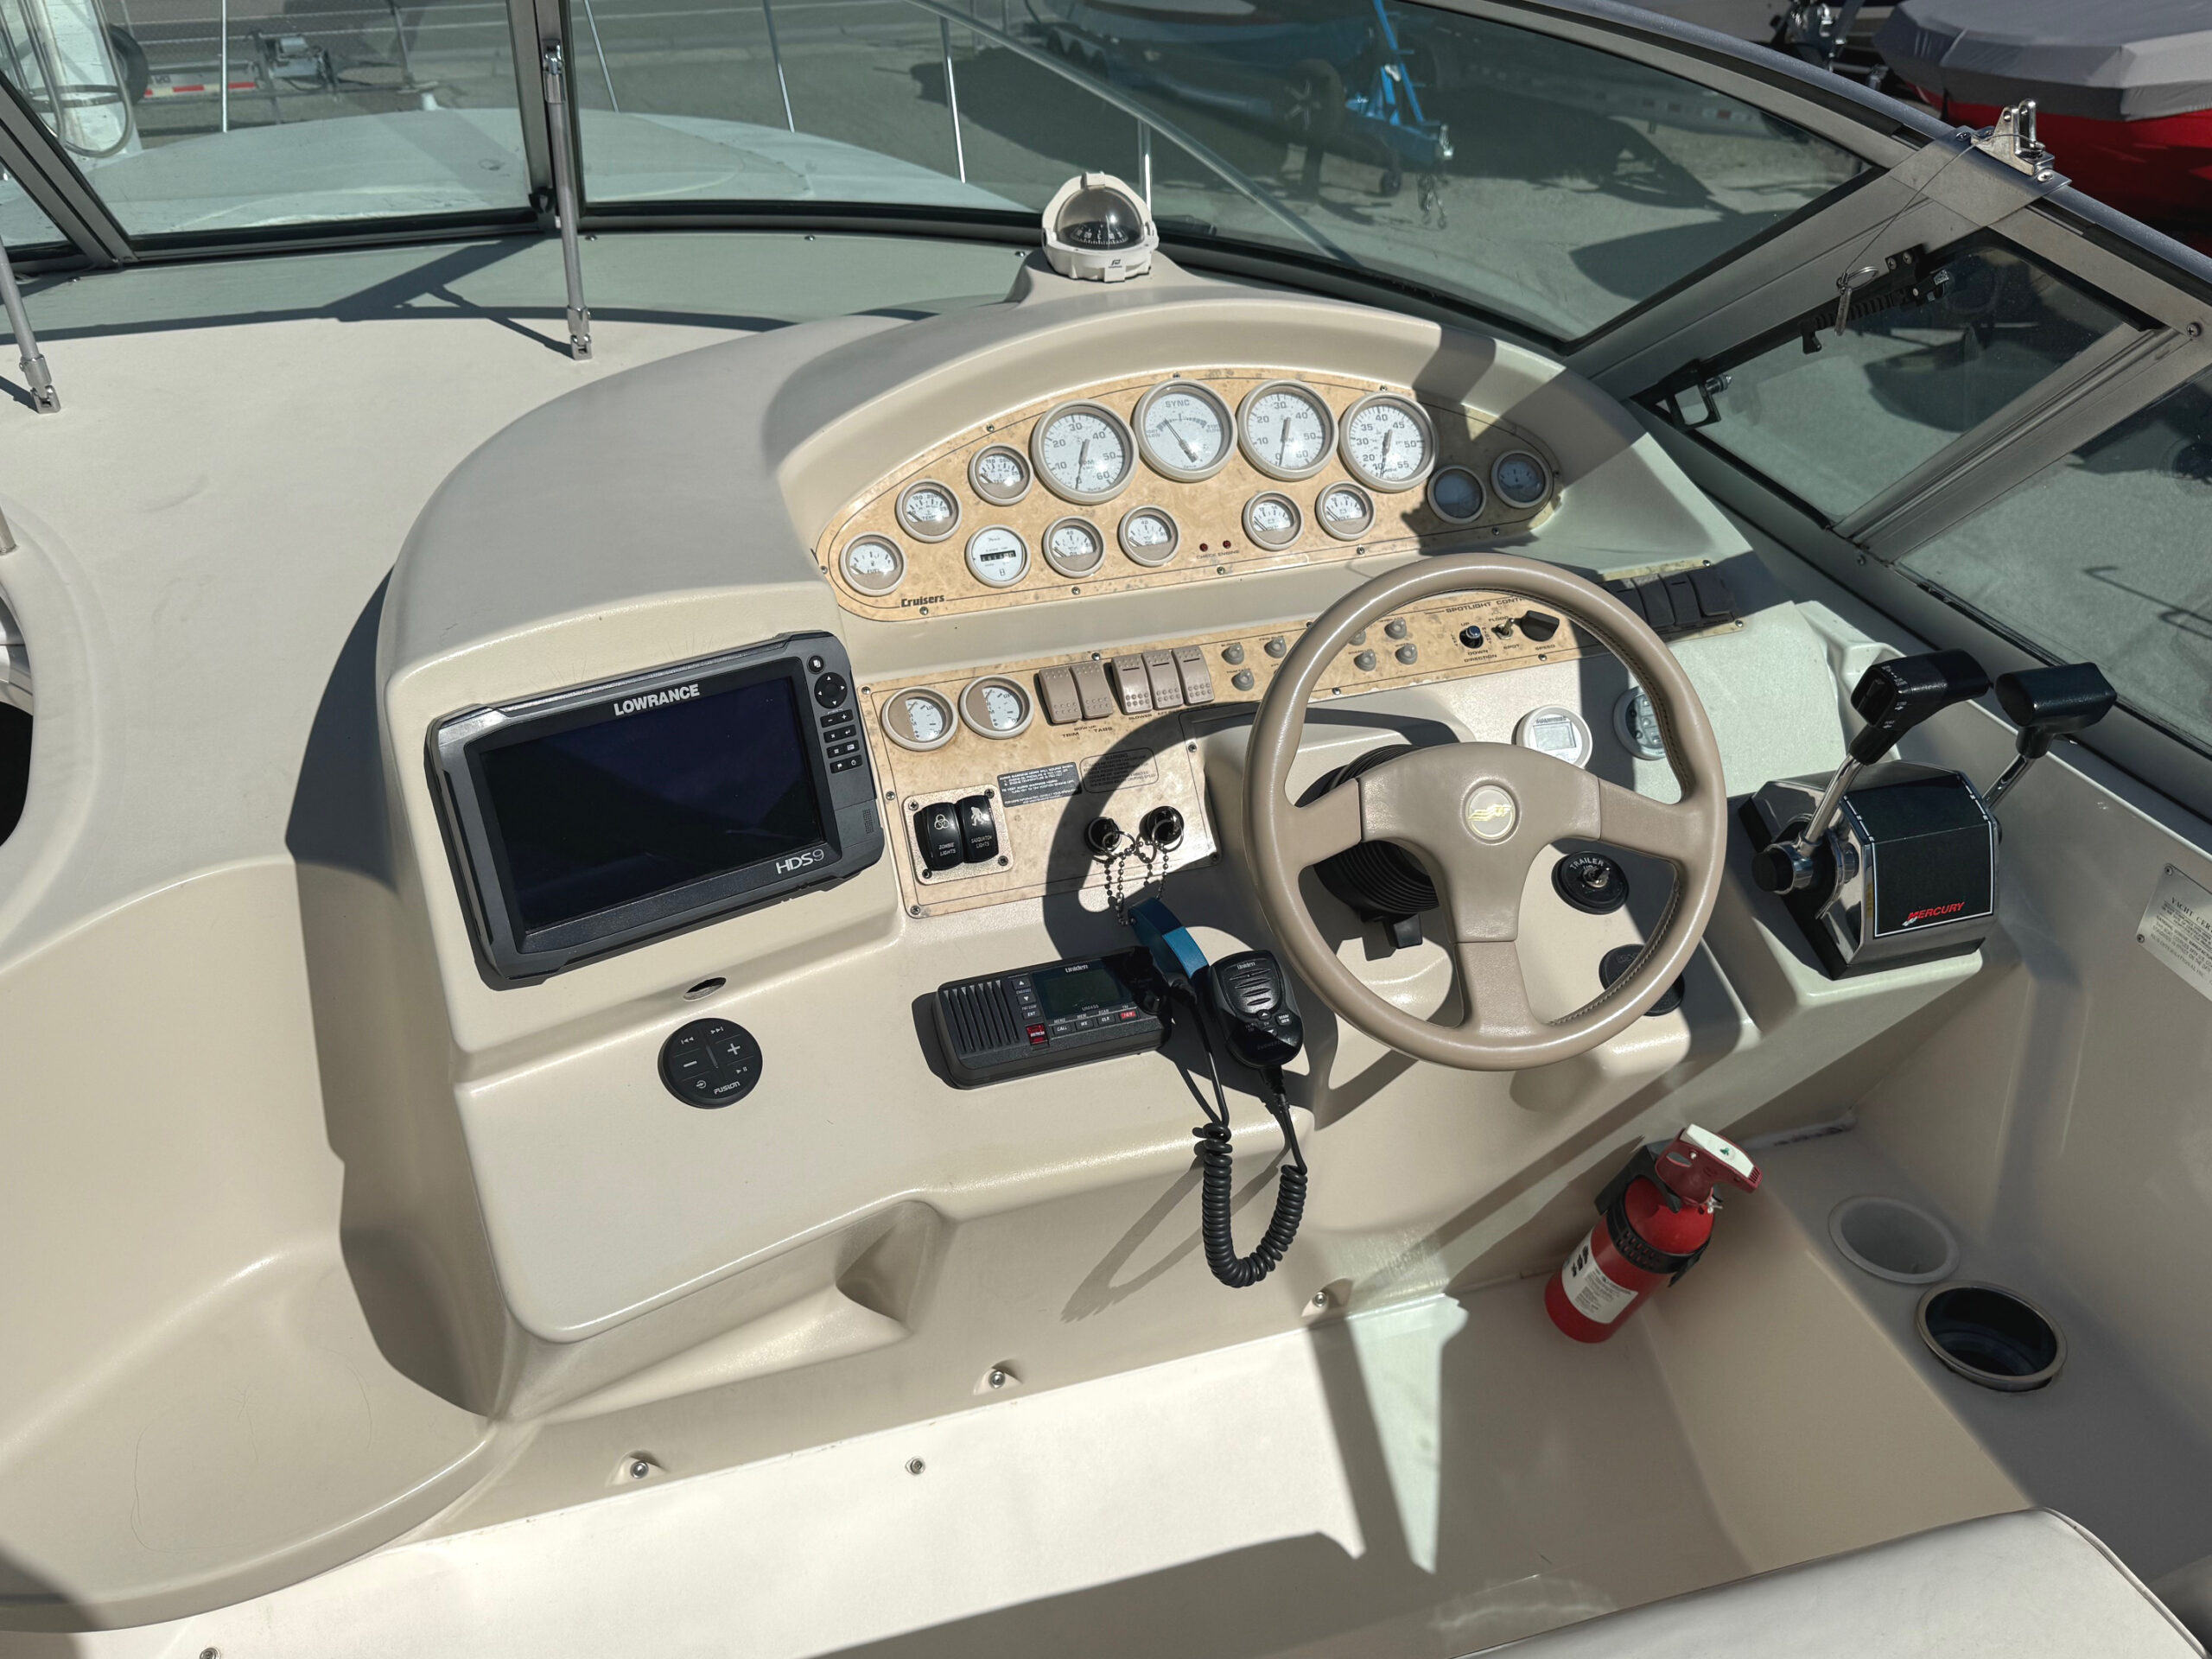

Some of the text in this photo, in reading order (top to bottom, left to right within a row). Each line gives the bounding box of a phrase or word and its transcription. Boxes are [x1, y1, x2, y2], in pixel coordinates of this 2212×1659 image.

[1165, 399, 1191, 408] SYNC
[1069, 423, 1083, 431] 30
[1093, 431, 1106, 440] 40
[1304, 432, 1316, 441] 50
[1052, 439, 1066, 448] 20
[1103, 452, 1116, 461] 50
[1096, 471, 1110, 480] 60
[901, 595, 944, 607] Cruisers
[1446, 601, 1491, 613] SPOTLIGHT
[613, 683, 700, 715] LOWRANCE
[971, 835, 992, 843] SASQUATCH
[940, 848, 956, 856] LIGHTS
[776, 849, 824, 874] HDS9
[1569, 857, 1604, 869] TRAILER
[1907, 901, 1966, 921] MERCURY
[2171, 896, 2193, 917] YACHT
[1065, 964, 1089, 973] Uniden
